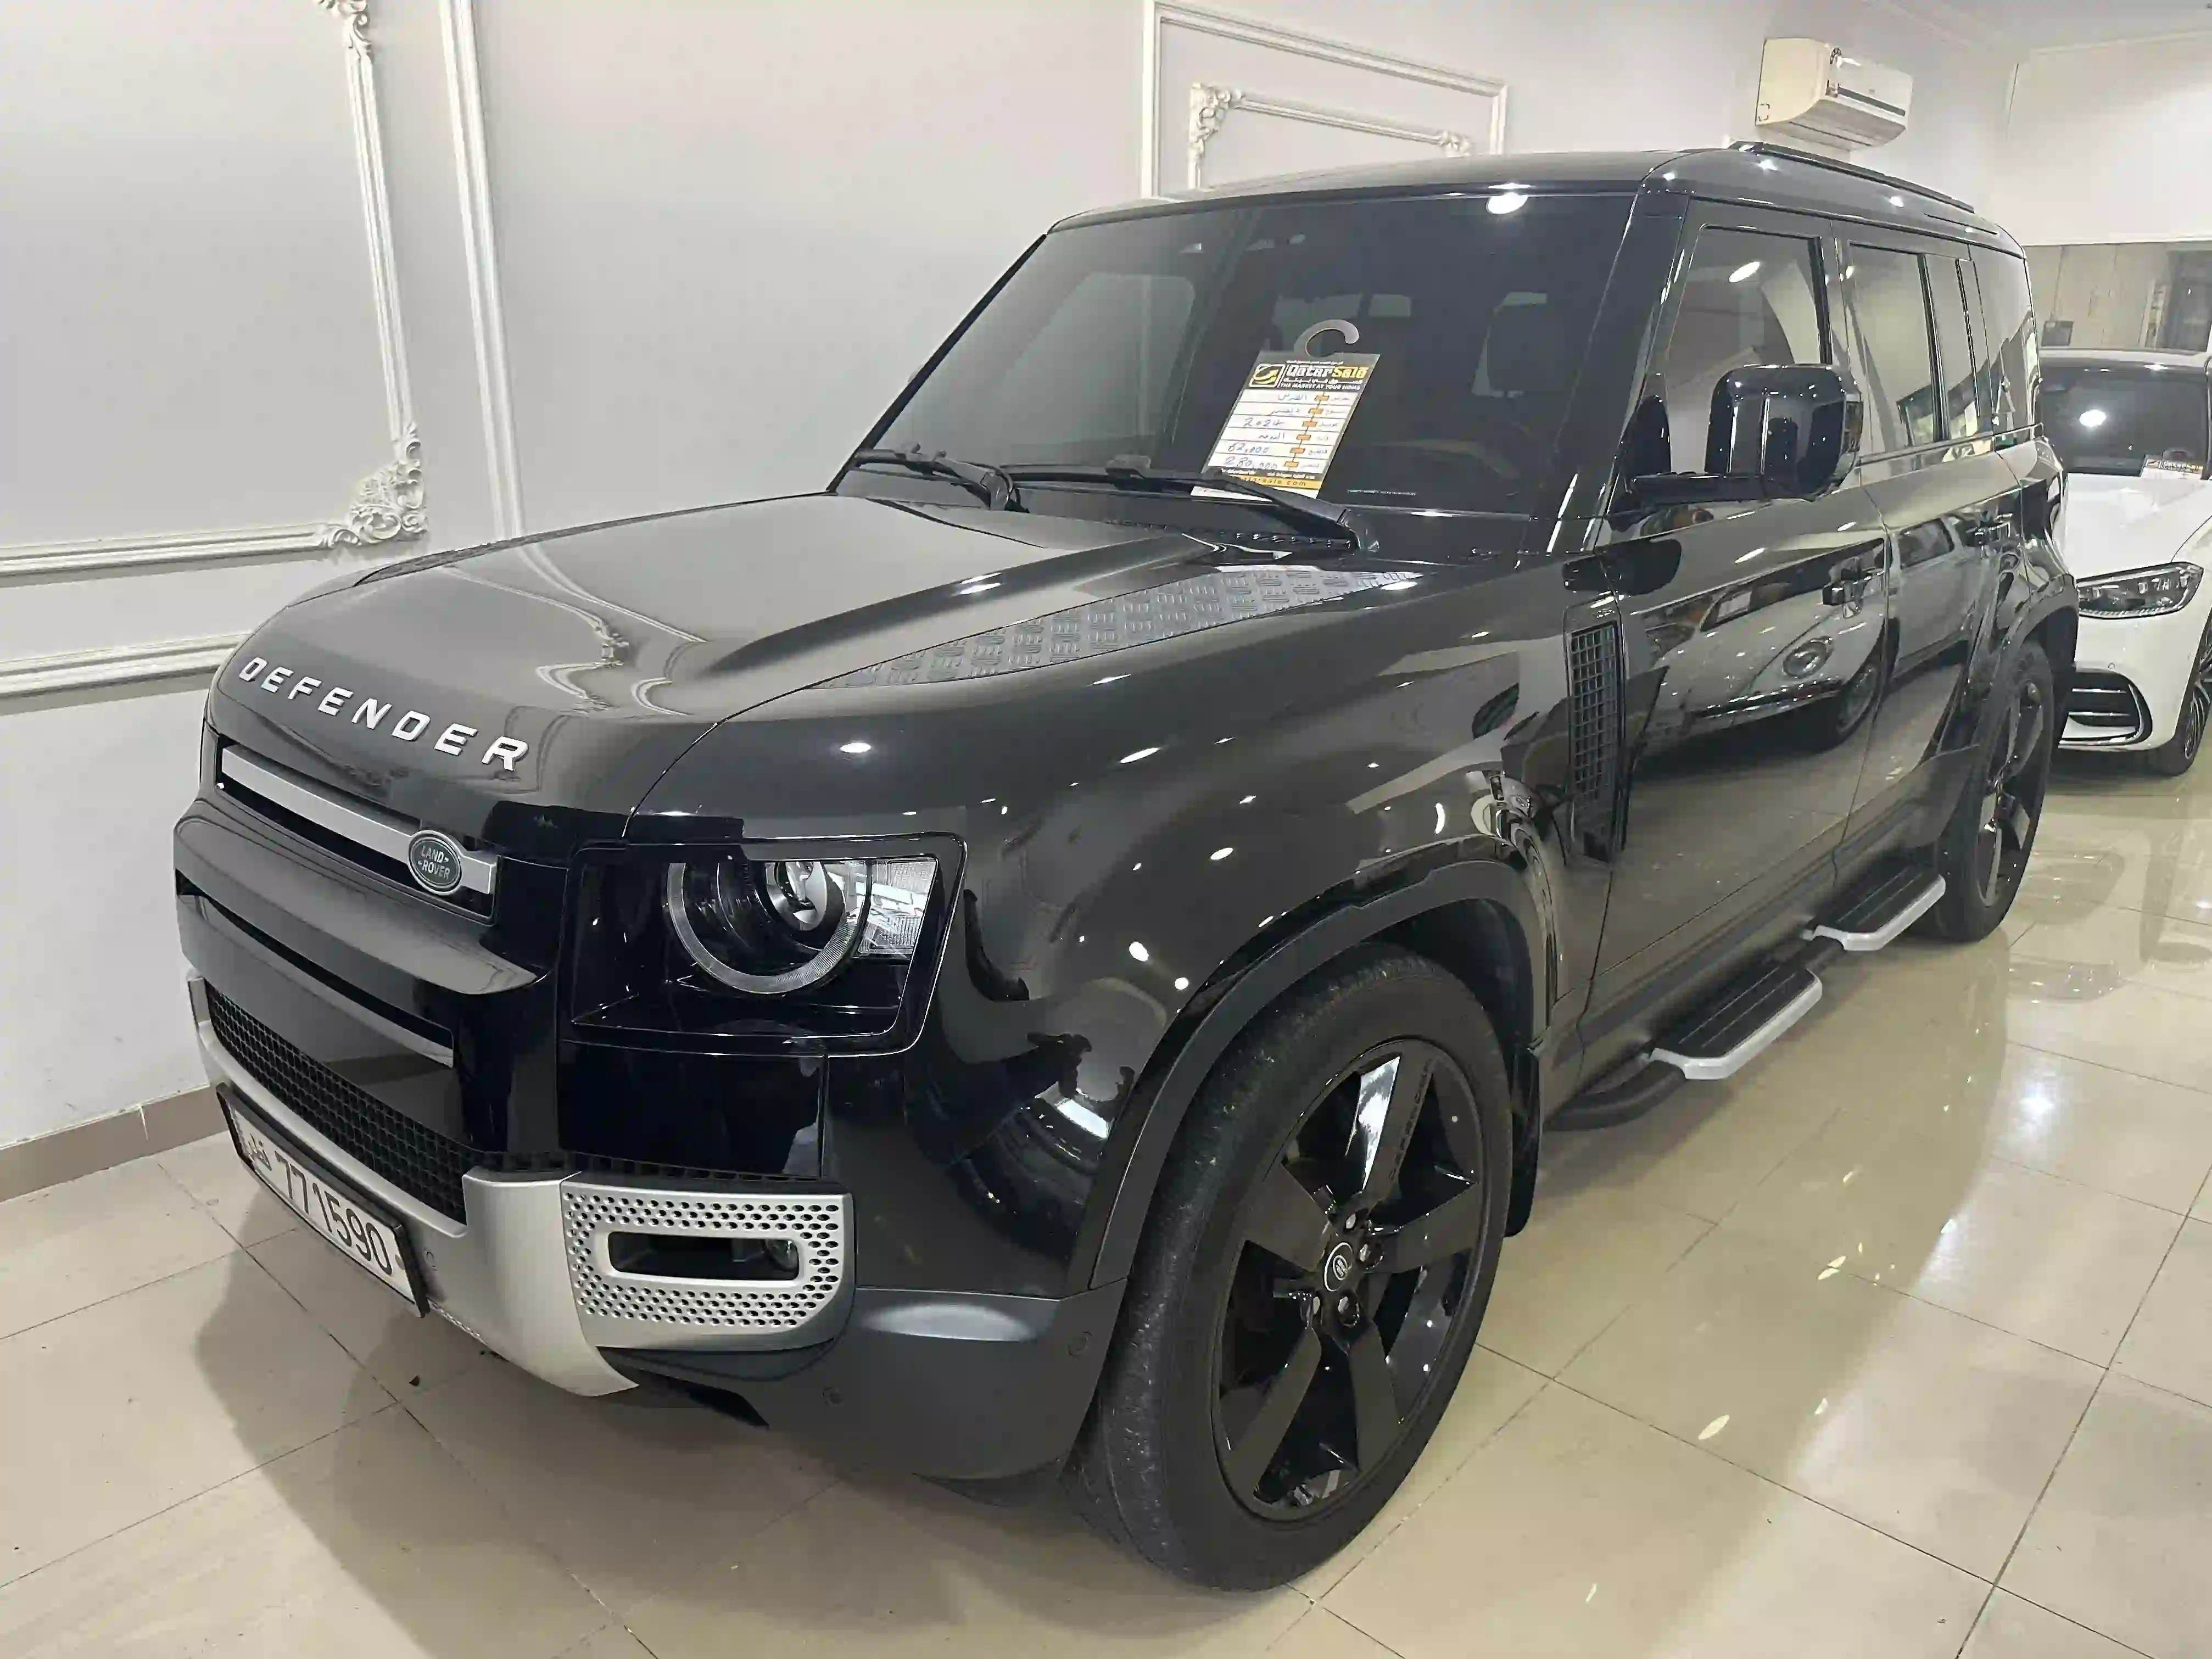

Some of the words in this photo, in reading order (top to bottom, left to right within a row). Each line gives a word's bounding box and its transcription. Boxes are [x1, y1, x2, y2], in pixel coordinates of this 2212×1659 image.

[239, 657, 529, 772] DEFENDER
[421, 846, 444, 863] LAND
[422, 860, 450, 879] ROVER
[275, 1149, 392, 1276] 771590
